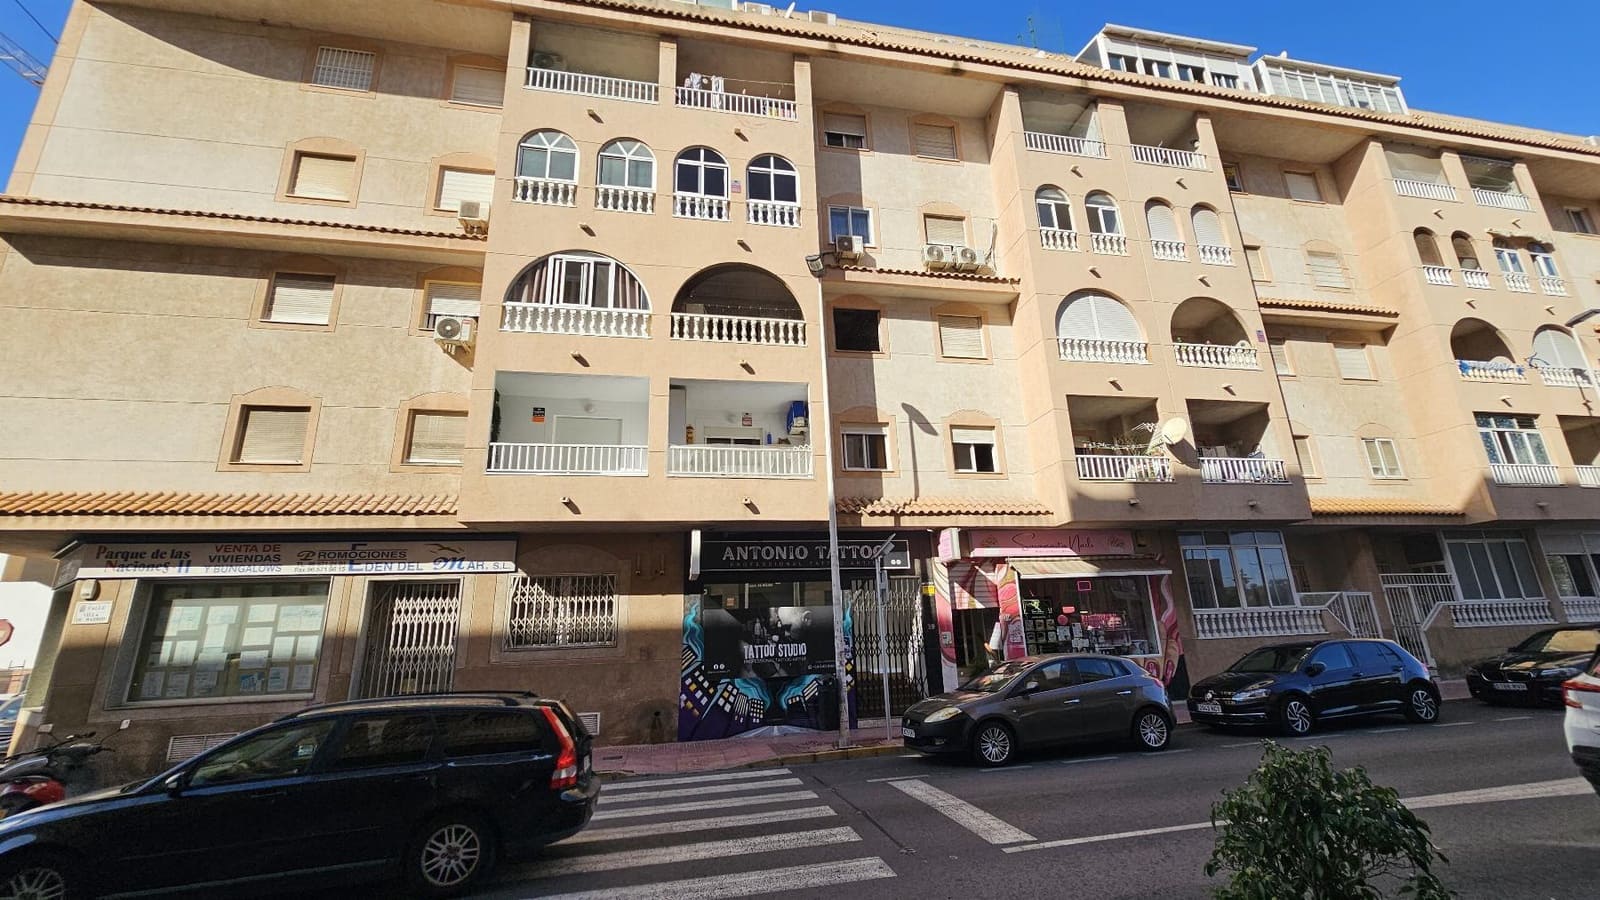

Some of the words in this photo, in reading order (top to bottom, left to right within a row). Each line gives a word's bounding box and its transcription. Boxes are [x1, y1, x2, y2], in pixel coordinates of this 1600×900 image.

[96, 546, 148, 562] Parque
[151, 549, 167, 560] de
[170, 549, 190, 560] las
[215, 544, 259, 553] VENTA
[262, 544, 281, 553] DE
[722, 545, 809, 561] ANTONIO
[208, 554, 281, 563] VIVIENDAS
[297, 549, 407, 560] PROMOCIONES
[104, 559, 170, 573] Naciones
[204, 565, 210, 573] Y
[213, 564, 282, 574] BUNGALOWS
[394, 561, 424, 571] DEL
[743, 644, 776, 660] TATTOO
[778, 642, 807, 657] STUDIO
